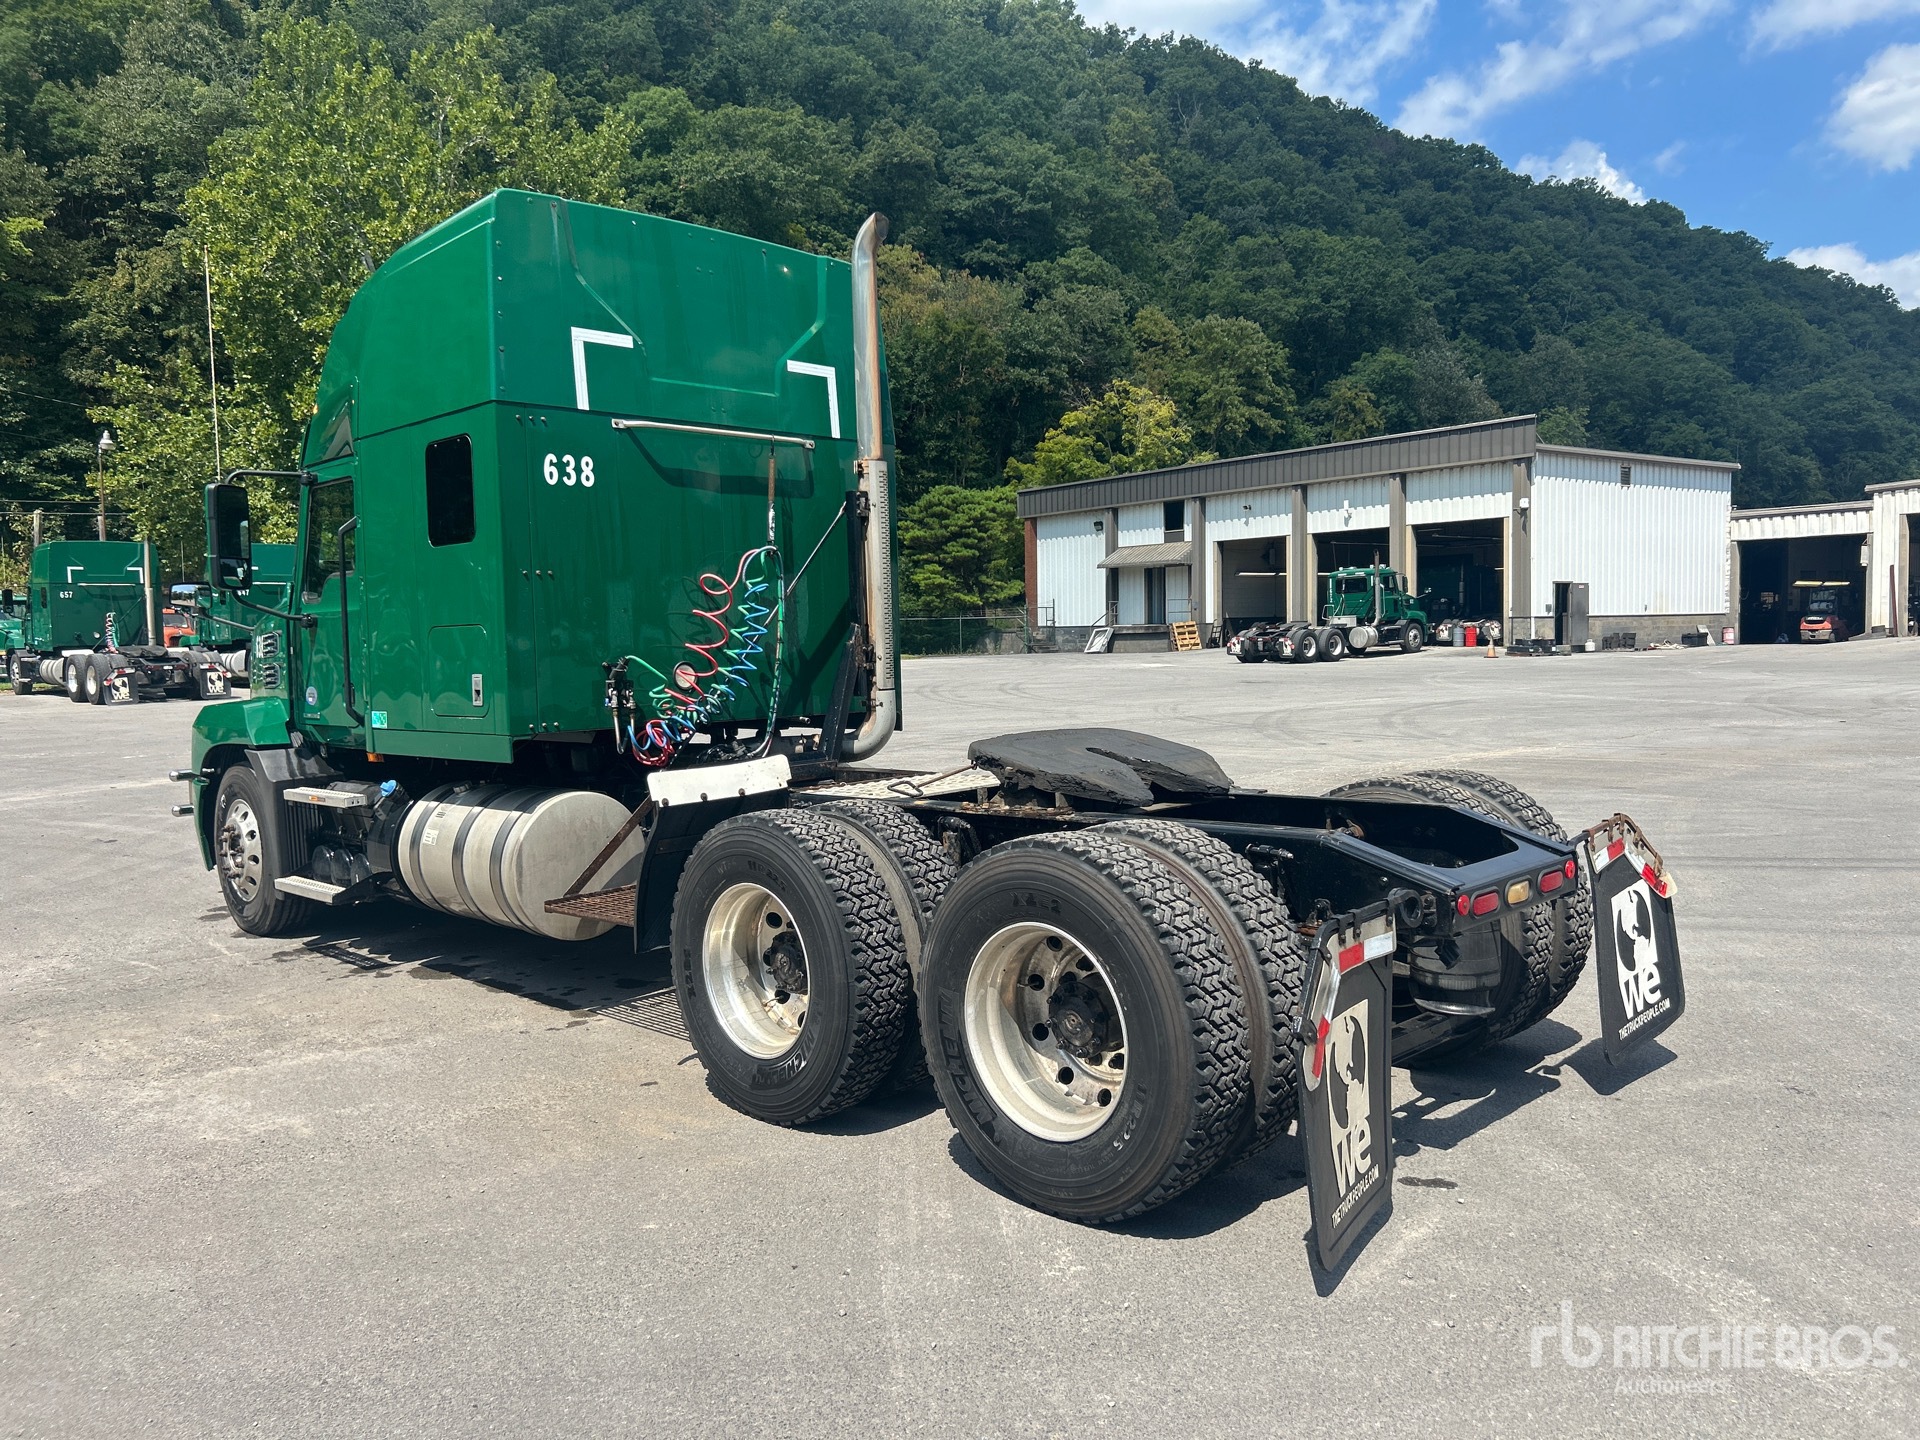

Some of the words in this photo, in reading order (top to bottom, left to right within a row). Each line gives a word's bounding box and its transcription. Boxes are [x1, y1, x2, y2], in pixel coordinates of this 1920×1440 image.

[543, 453, 595, 488] 638
[59, 591, 73, 599] 657
[1618, 997, 1671, 1041] THETRUCKPEOPLE.COM
